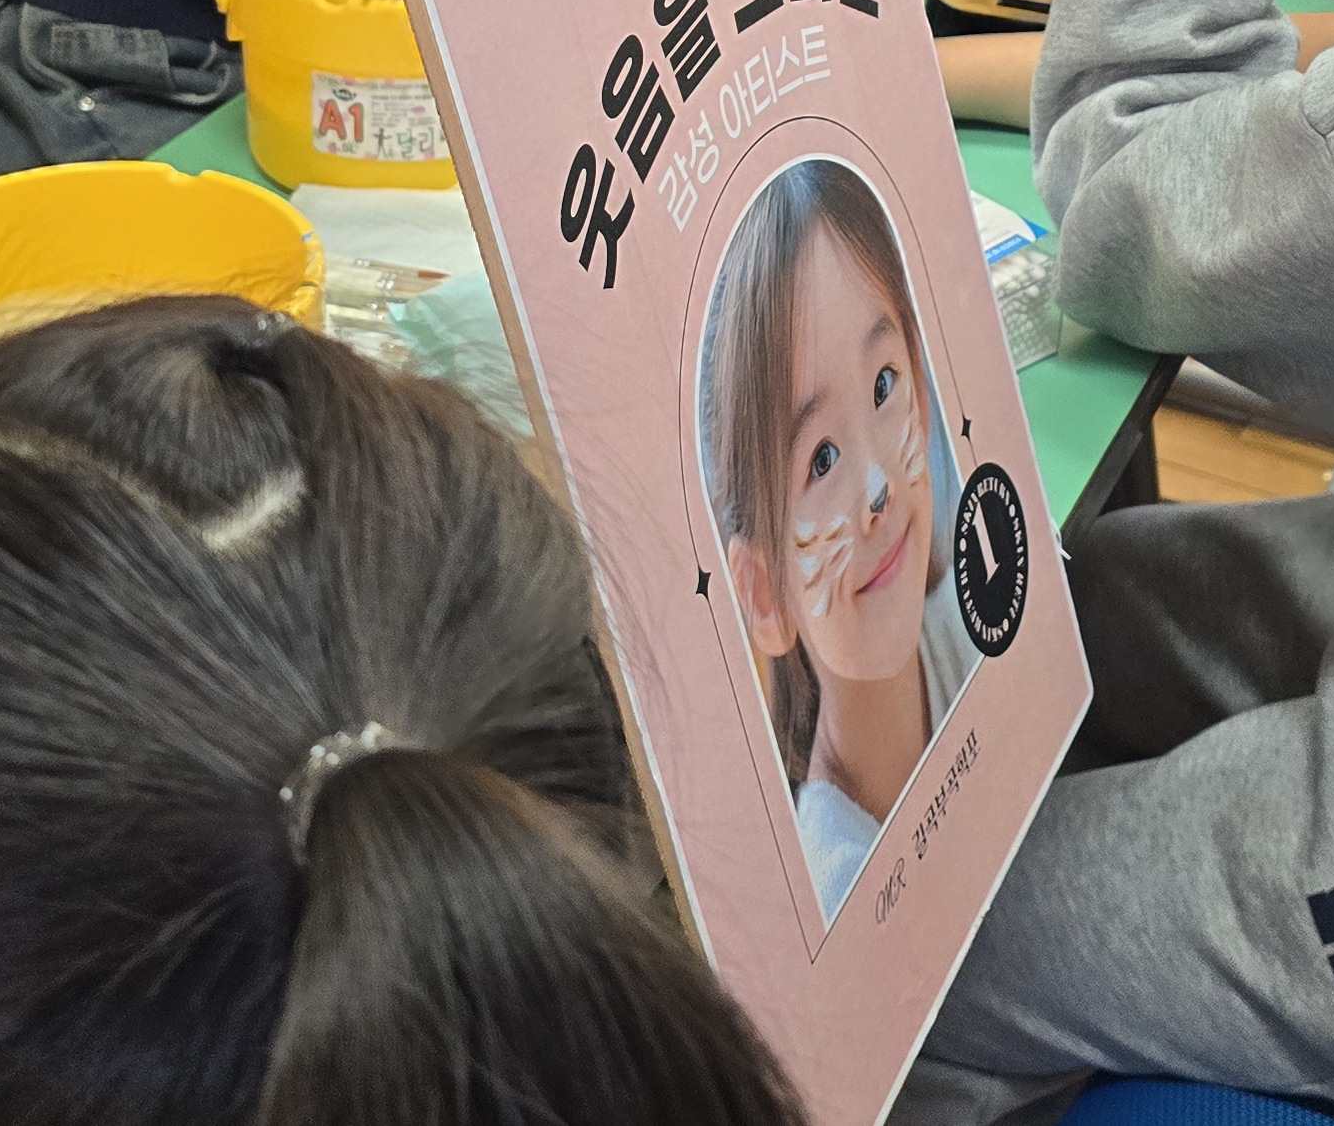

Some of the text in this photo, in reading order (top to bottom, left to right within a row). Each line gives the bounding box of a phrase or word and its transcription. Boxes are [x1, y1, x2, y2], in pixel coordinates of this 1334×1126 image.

[318, 98, 364, 143] A1
[658, 24, 831, 233] 감성 아티스트
[972, 501, 1000, 585] 1
